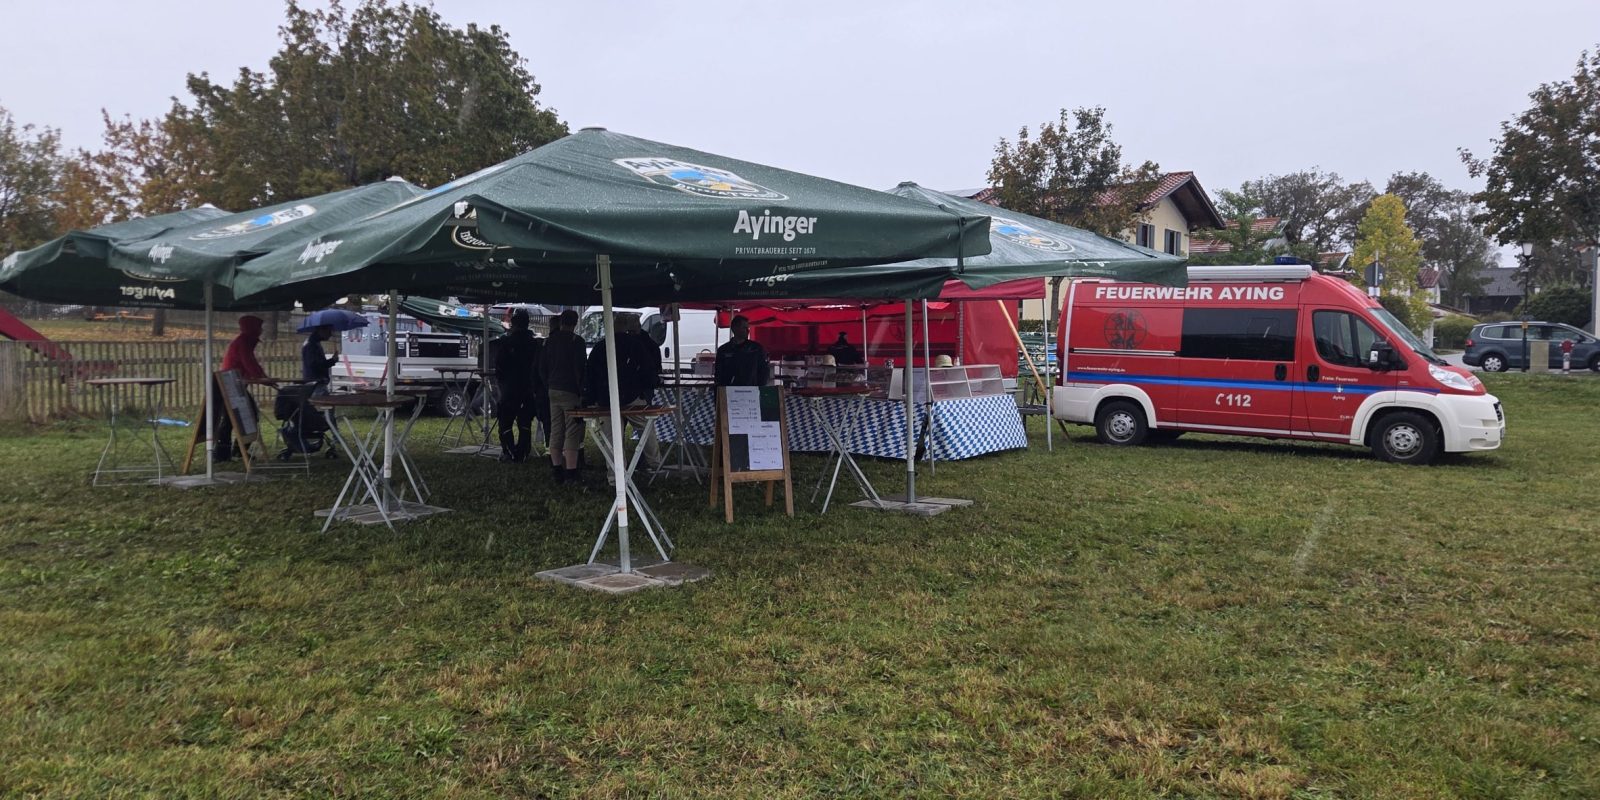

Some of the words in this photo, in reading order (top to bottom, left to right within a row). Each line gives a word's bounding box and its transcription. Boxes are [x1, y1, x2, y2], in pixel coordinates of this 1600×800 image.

[732, 209, 818, 242] Ayinger
[735, 247, 788, 255] PRIVATBRAUEREI
[788, 247, 803, 255] SEIT
[1095, 286, 1213, 300] FEUERWEHR
[1218, 287, 1285, 301] AYING
[1226, 393, 1252, 407] 112
